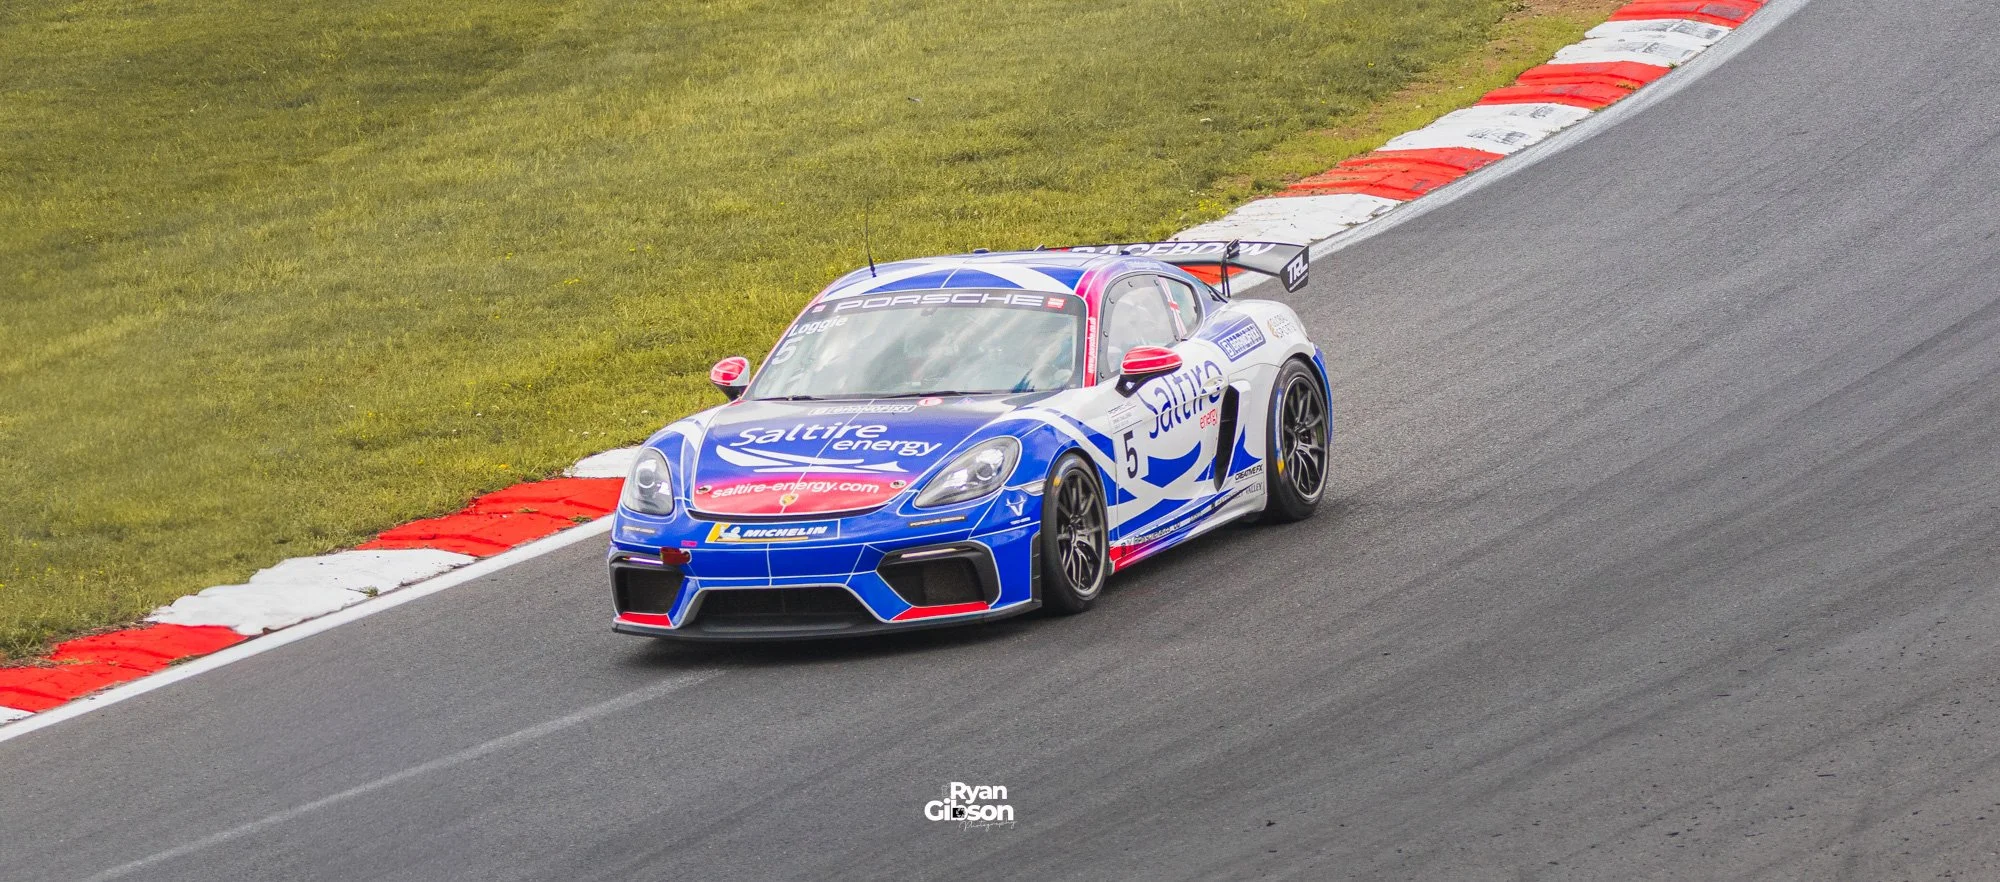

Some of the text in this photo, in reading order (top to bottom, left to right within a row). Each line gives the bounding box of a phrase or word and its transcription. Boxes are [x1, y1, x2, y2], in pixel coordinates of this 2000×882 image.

[1287, 253, 1309, 285] TRL
[834, 293, 1045, 313] PORSCHE
[787, 315, 849, 338] Loggie
[771, 336, 805, 365] 5
[730, 421, 888, 448] Saltire
[832, 437, 943, 457] energy
[1123, 430, 1139, 479] 5
[711, 477, 880, 499] saltire-energy.com
[743, 525, 828, 538] MICHELIN
